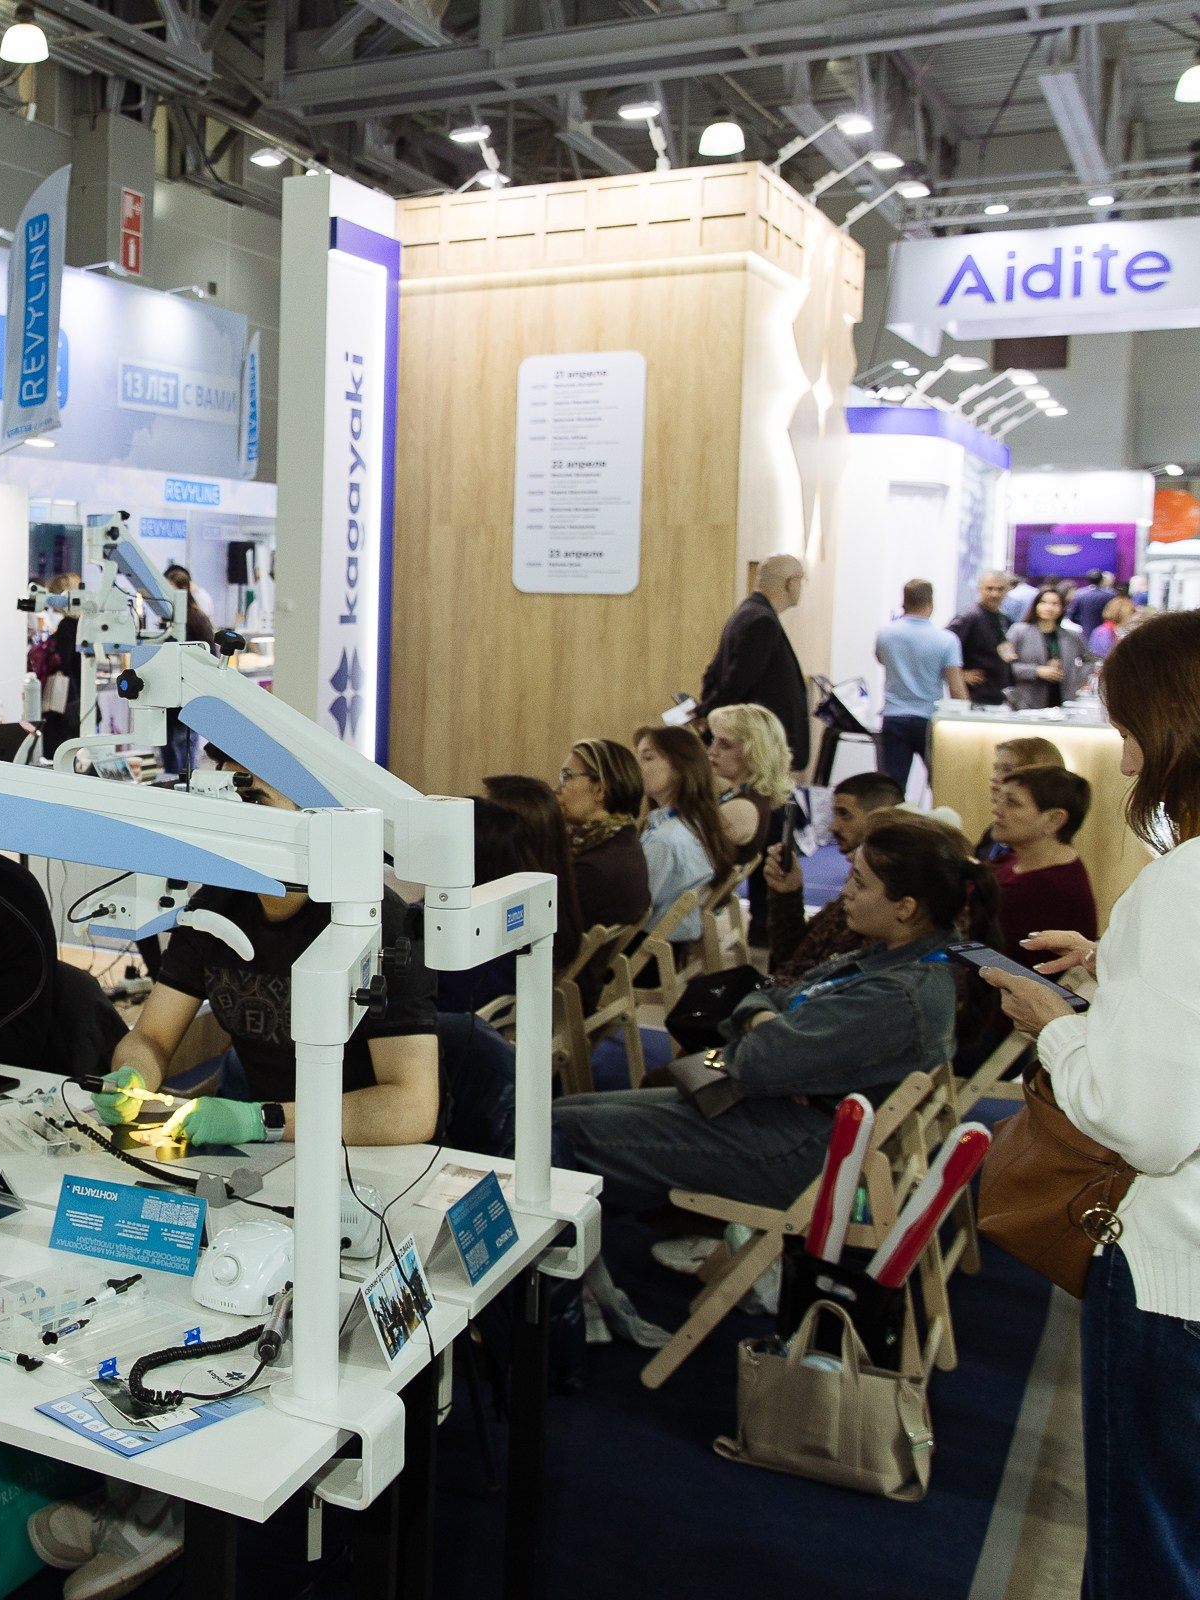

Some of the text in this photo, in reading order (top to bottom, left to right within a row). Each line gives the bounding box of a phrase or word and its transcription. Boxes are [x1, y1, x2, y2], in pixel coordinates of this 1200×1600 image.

[939, 244, 1171, 306] Aidite
[21, 219, 47, 402] REVYLINE
[123, 370, 143, 399] 13
[145, 375, 177, 404] ЛЕТ
[167, 480, 220, 504] REVYLINE
[339, 351, 366, 626] kagayaki
[507, 909, 524, 923] zumax
[71, 1184, 119, 1202] КОНТАКТЫ
